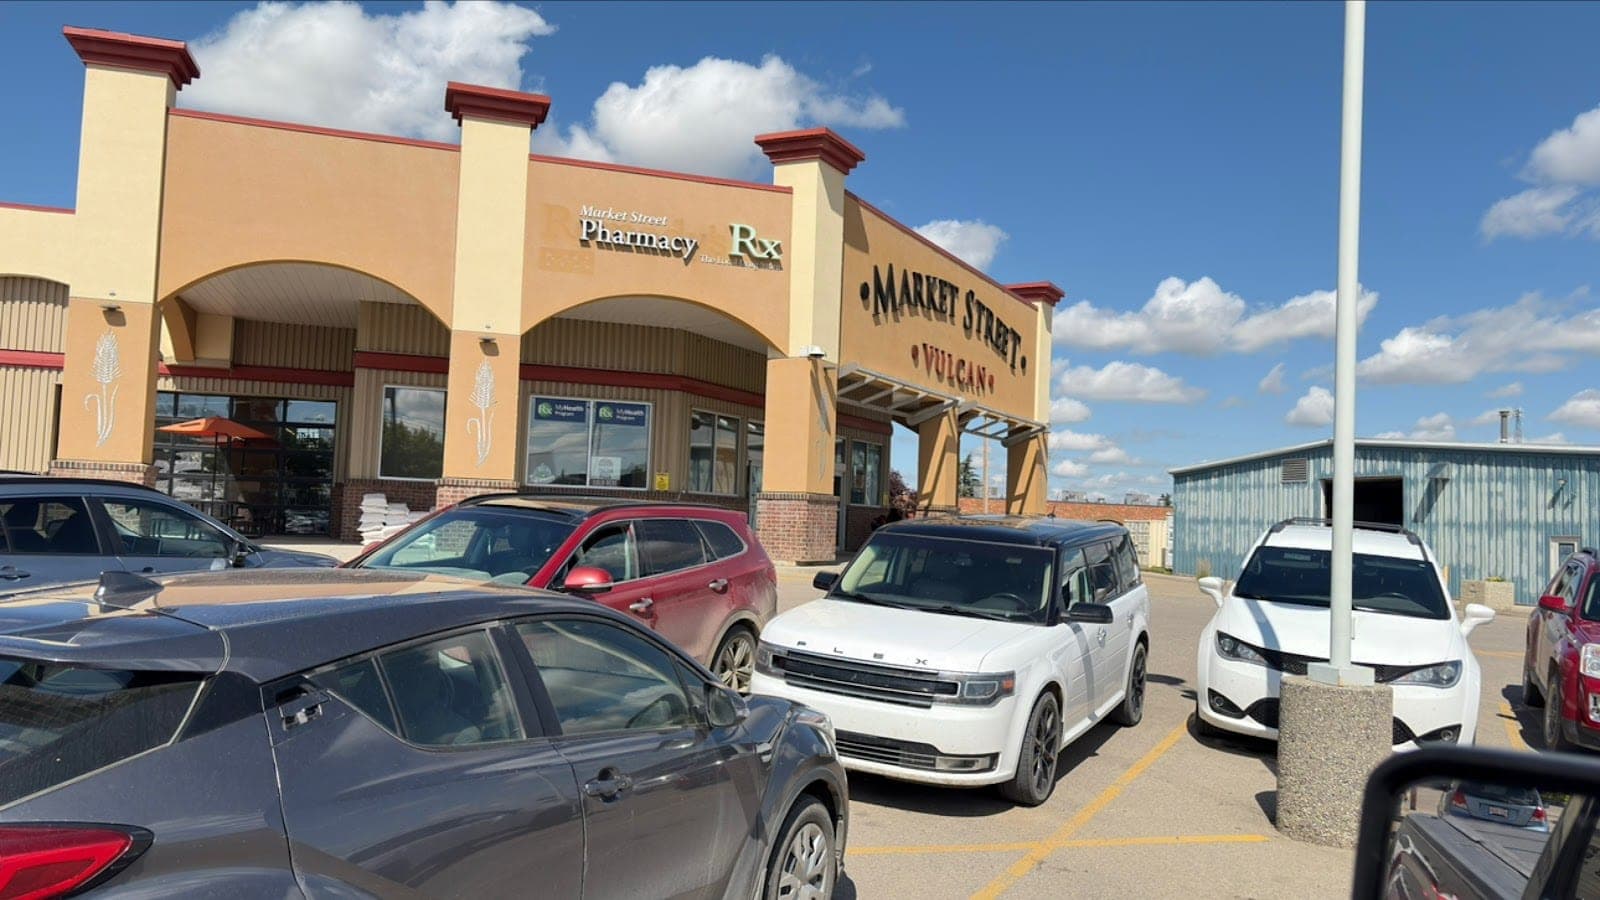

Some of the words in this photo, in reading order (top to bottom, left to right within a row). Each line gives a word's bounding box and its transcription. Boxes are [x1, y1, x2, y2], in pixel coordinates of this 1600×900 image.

[579, 205, 628, 221] Market
[630, 210, 669, 226] Street
[579, 218, 698, 260] Pharmacy
[728, 223, 784, 260] Rx
[872, 263, 960, 318] MARKET
[963, 289, 1022, 370] STREET
[922, 343, 987, 393] VULCAN
[796, 640, 929, 666] FLEX
